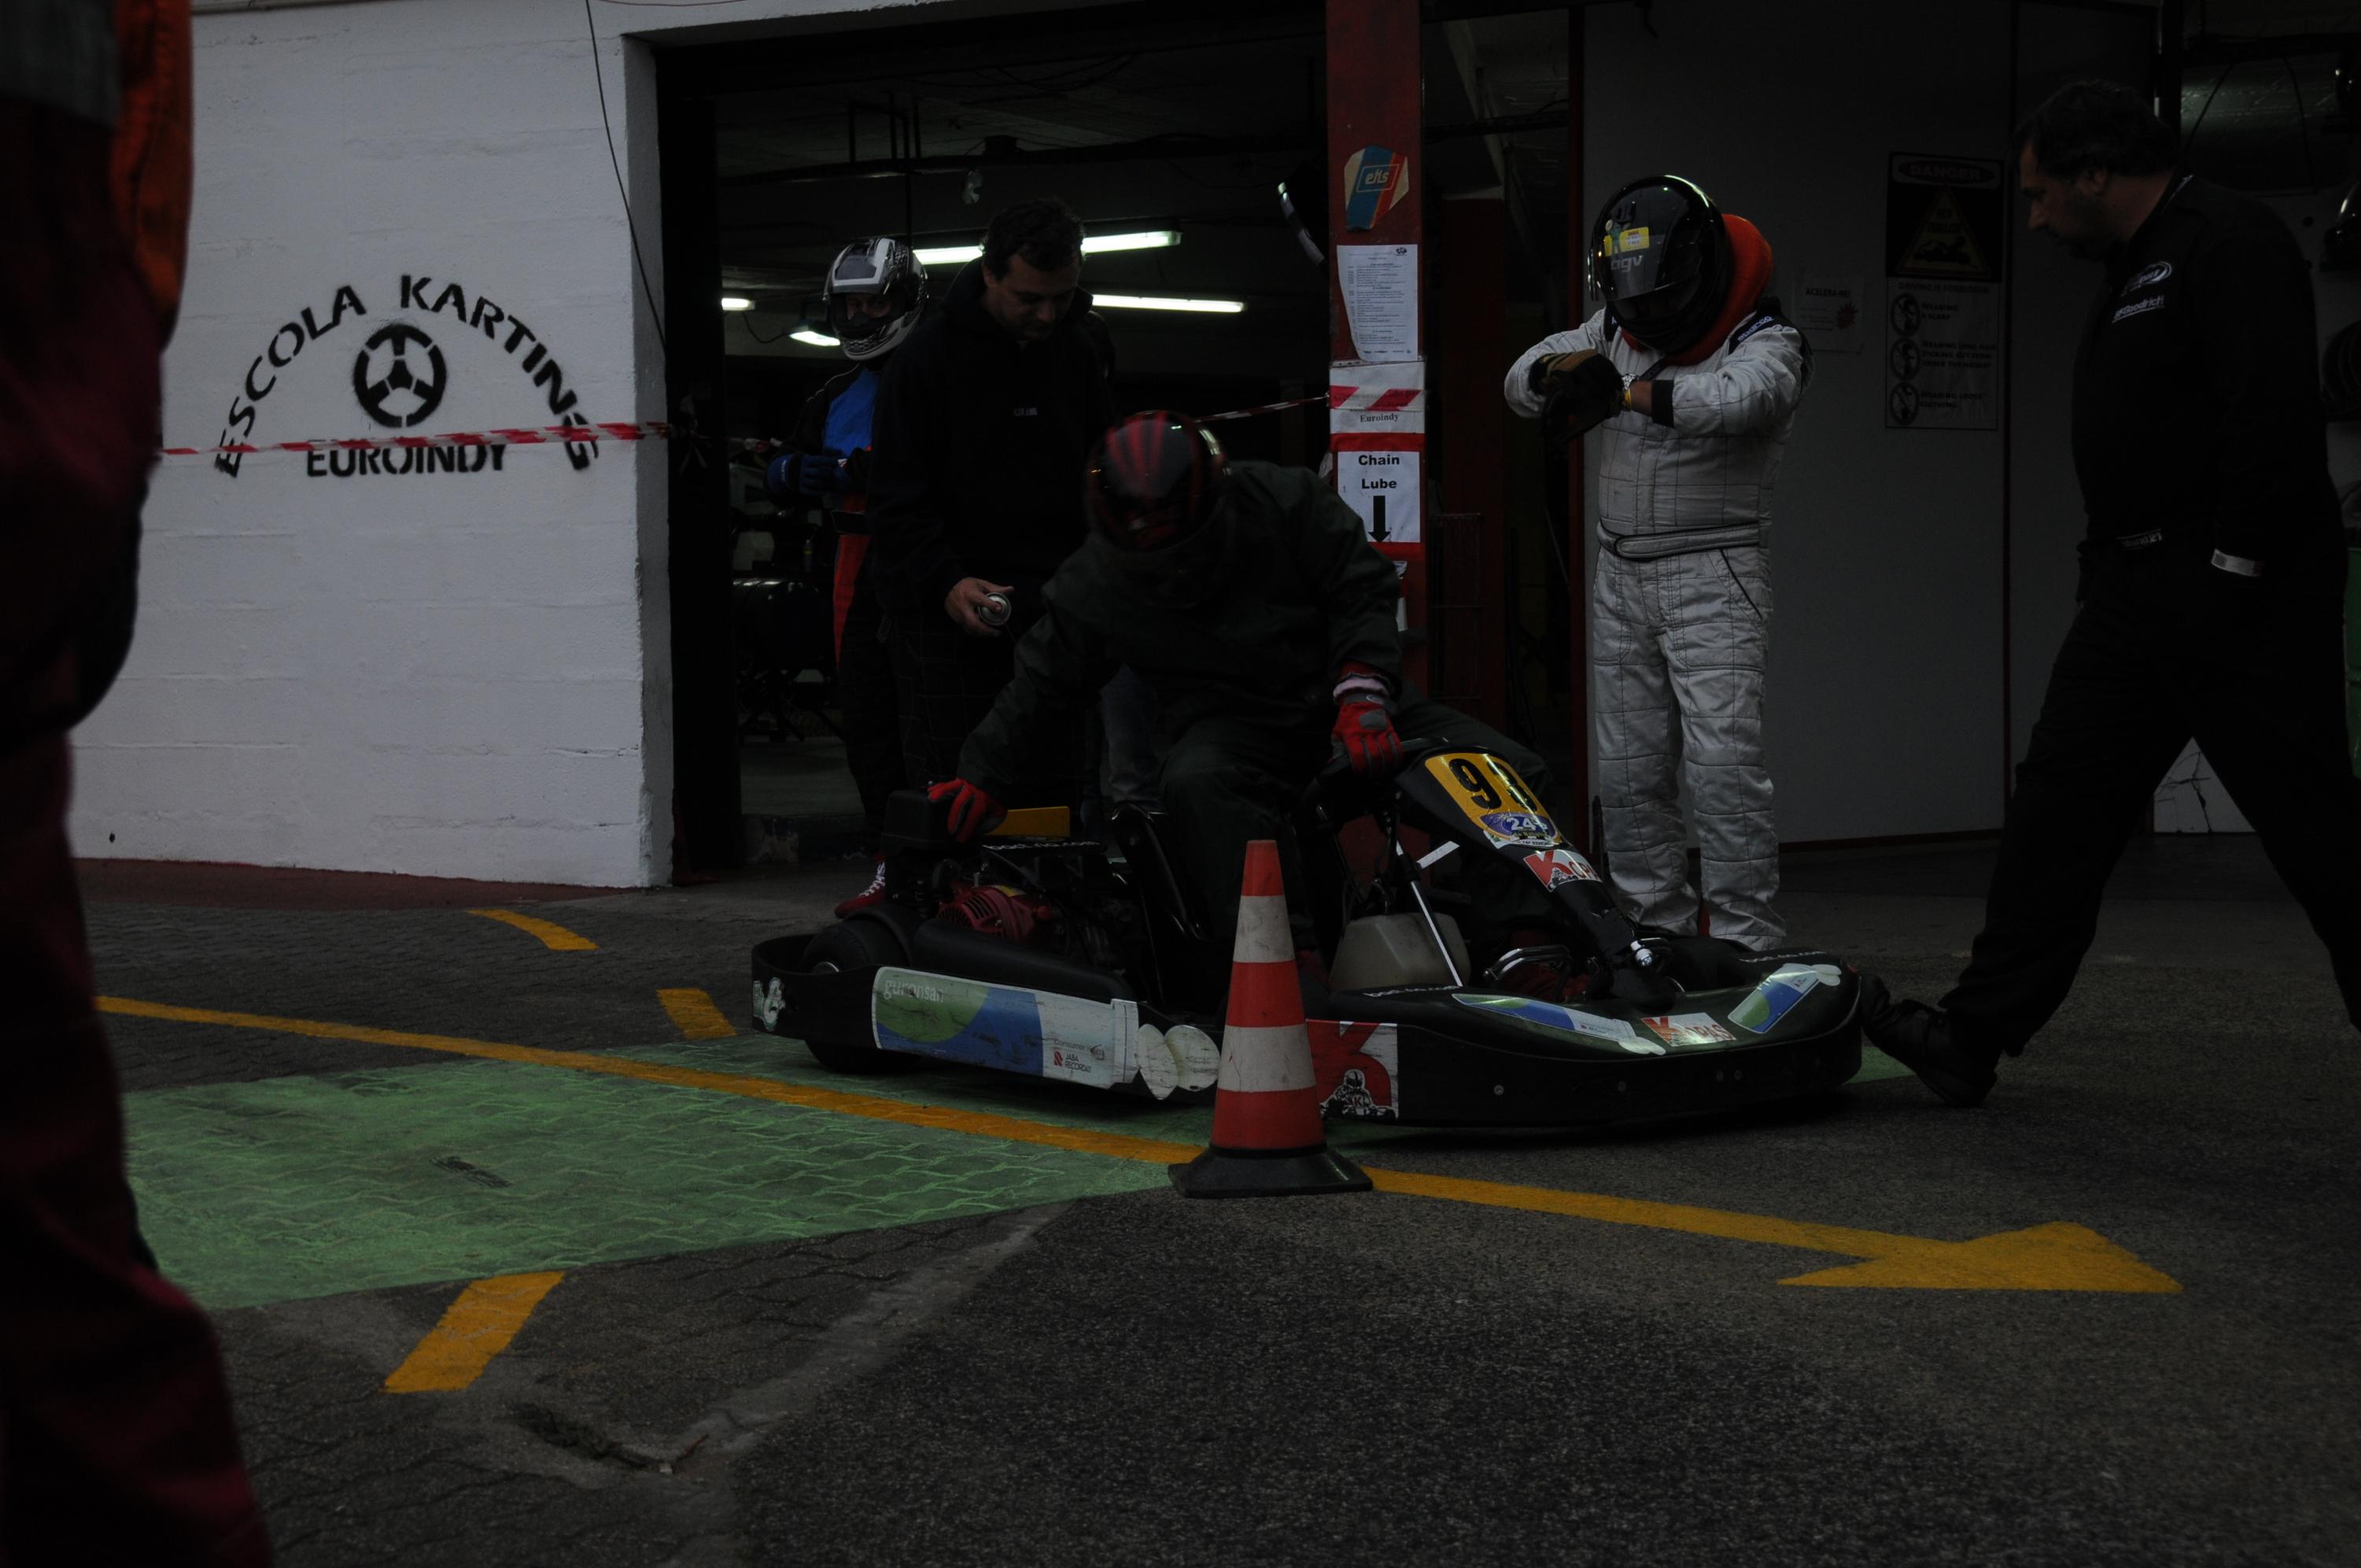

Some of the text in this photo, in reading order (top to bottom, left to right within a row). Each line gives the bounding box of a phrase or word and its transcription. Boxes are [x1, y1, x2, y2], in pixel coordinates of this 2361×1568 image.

[1909, 164, 1983, 180] DANGER
[214, 275, 599, 478] ESCOLA KARTING
[1359, 413, 1400, 423] Euroindy
[307, 439, 506, 478] EUROINDY
[1358, 455, 1400, 466] Chain
[1361, 478, 1397, 490] Lube
[882, 980, 944, 1003] guronsan
